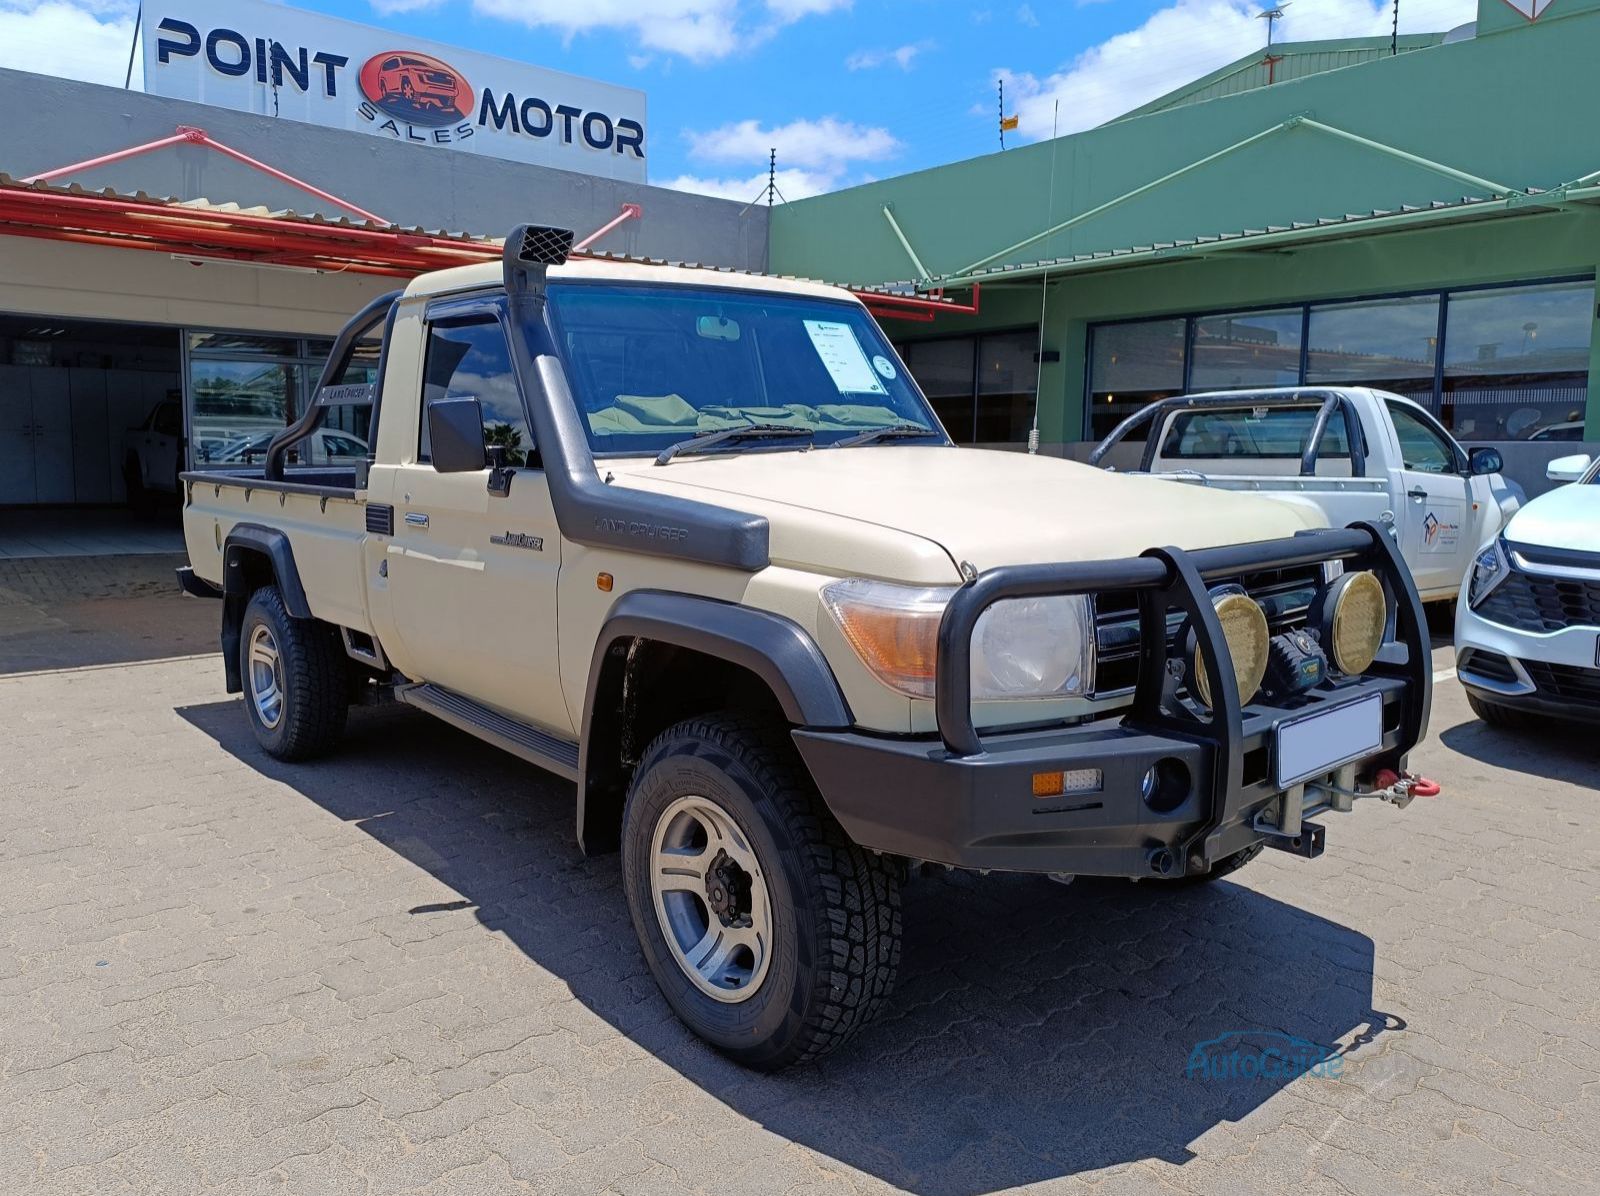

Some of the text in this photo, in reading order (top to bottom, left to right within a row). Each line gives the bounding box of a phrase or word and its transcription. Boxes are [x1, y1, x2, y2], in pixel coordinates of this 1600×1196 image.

[156, 16, 646, 159] POINT MOTOR
[358, 101, 475, 143] SALES
[594, 516, 689, 541] LAND CRUISER
